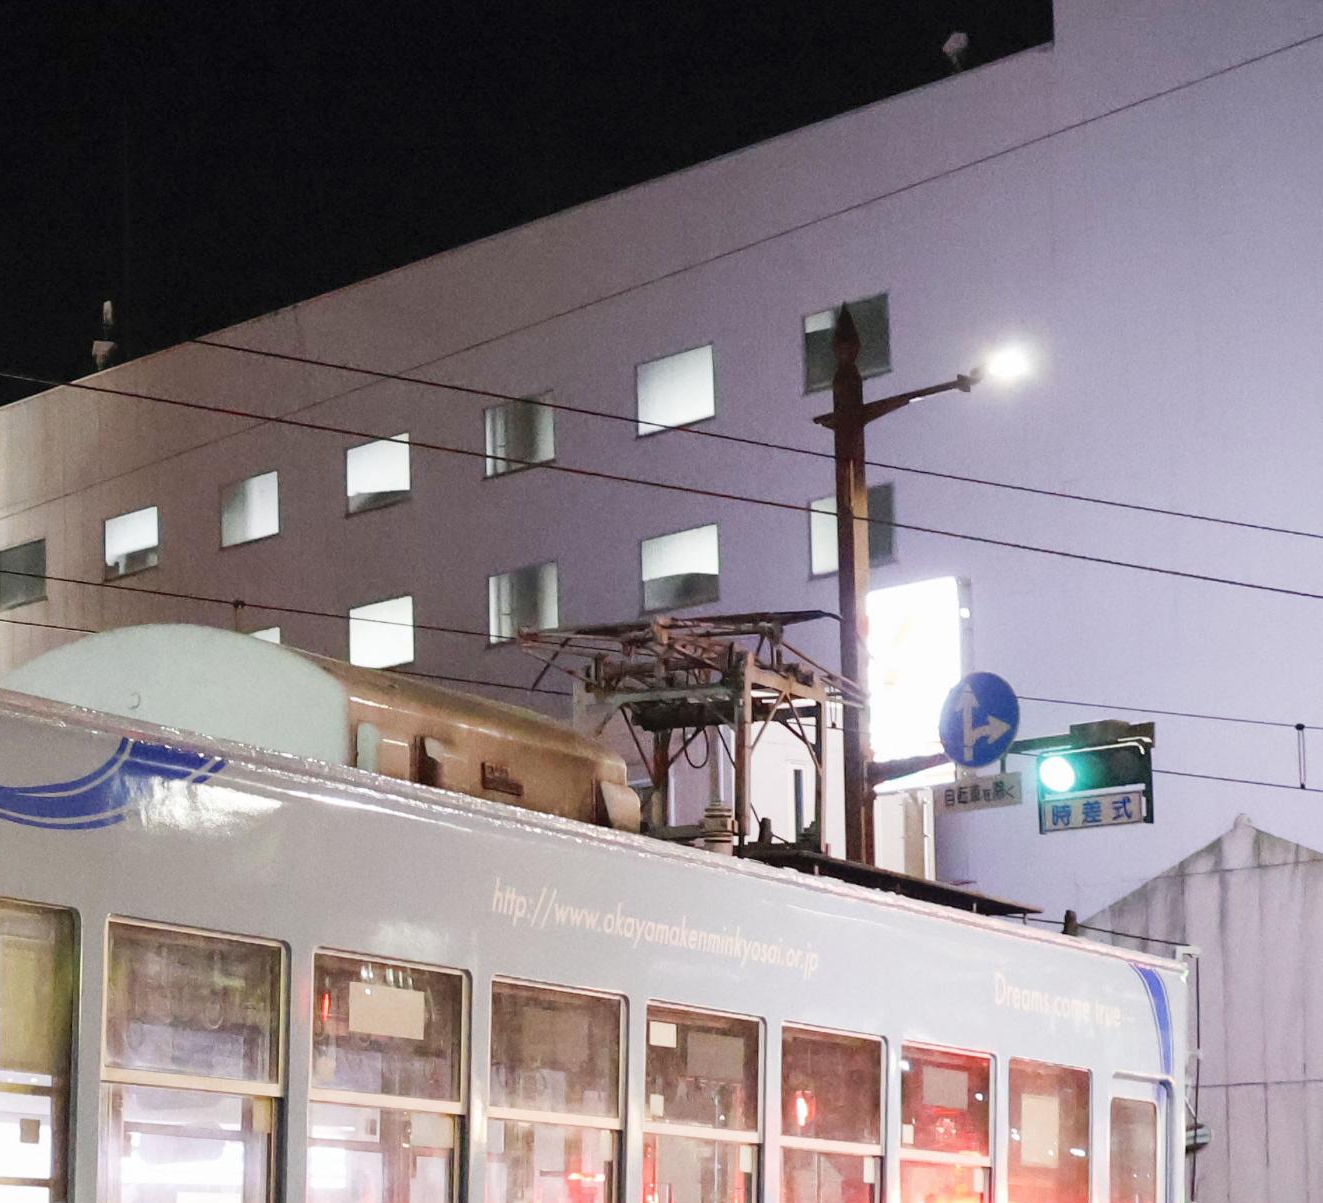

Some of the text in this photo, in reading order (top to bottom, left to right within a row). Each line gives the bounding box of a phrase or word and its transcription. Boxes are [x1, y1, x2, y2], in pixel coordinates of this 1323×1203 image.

[943, 779, 1016, 808] 自転車を除く
[1051, 796, 1134, 827] 時差式
[491, 878, 820, 980] http://www.okayamakenminkyosai.or.jp
[994, 971, 1052, 1013] Dreams
